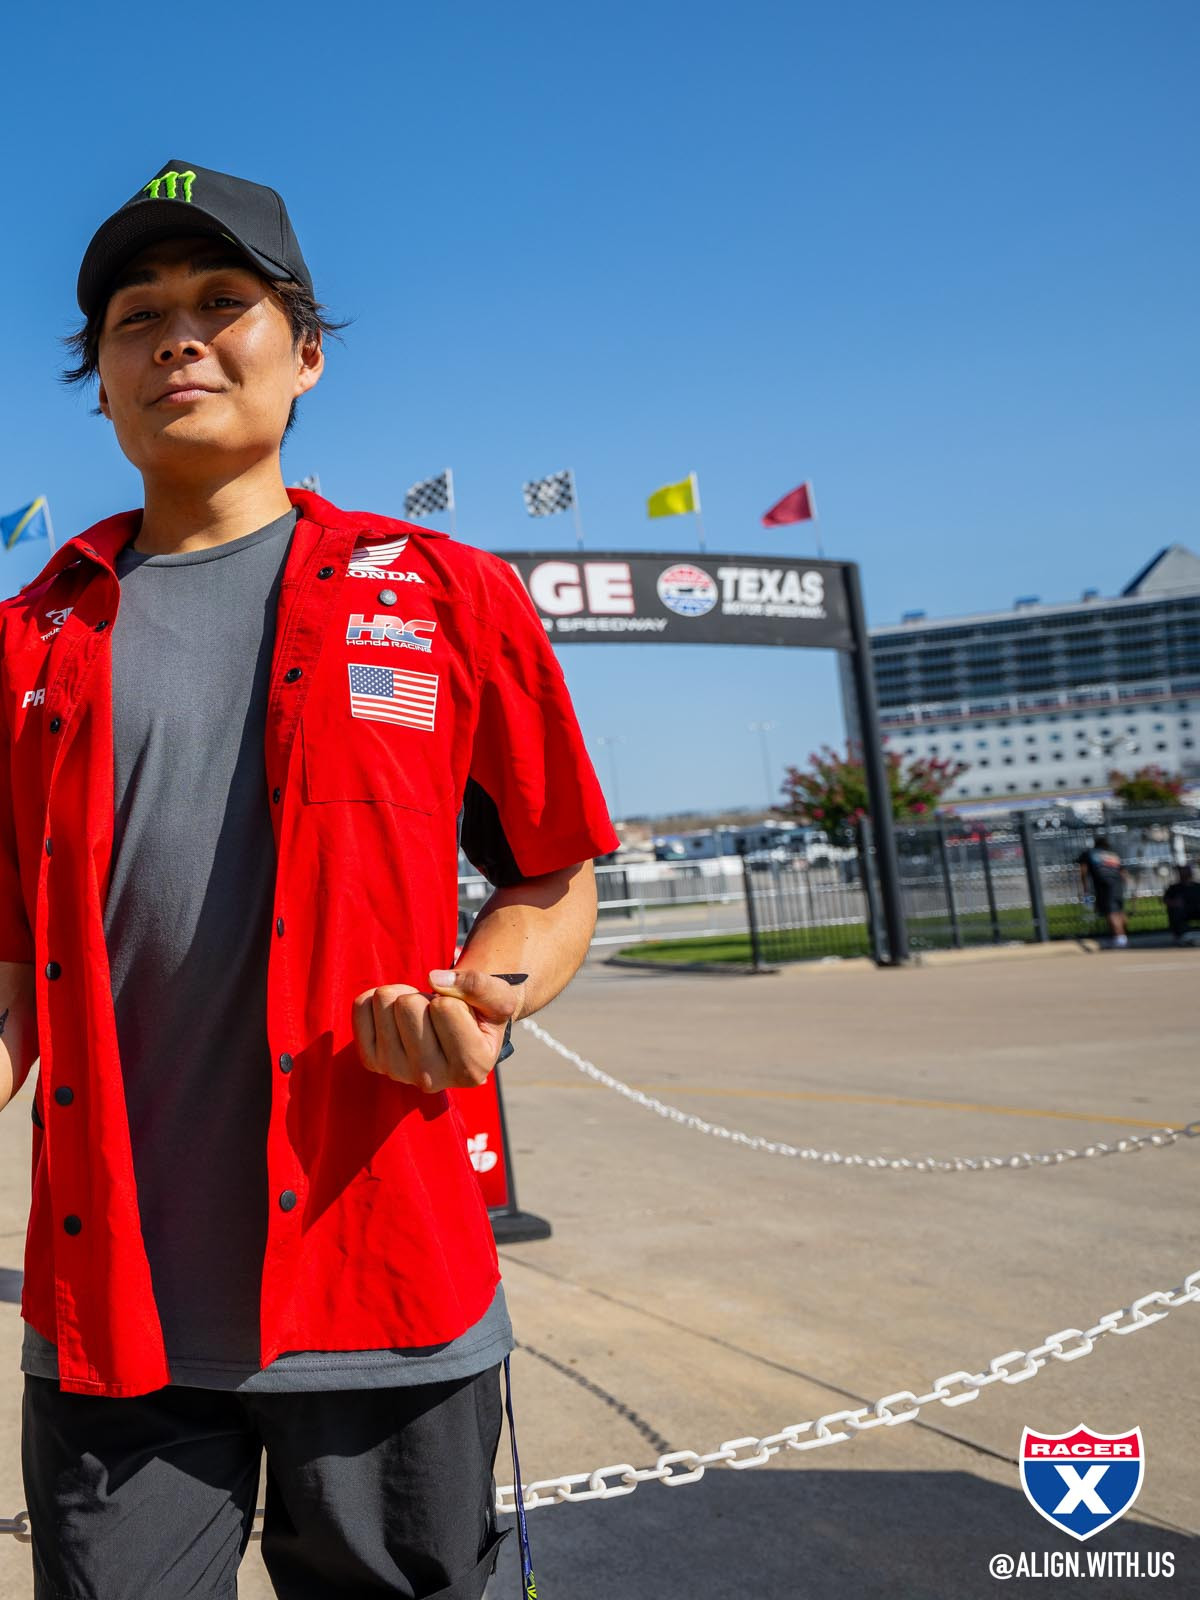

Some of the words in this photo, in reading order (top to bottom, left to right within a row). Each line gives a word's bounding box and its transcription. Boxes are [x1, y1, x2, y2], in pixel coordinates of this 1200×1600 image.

[345, 570, 425, 584] ONDA
[717, 566, 825, 606] TEXAS
[345, 613, 437, 649] HRC
[555, 617, 668, 632] SPEEDWAY
